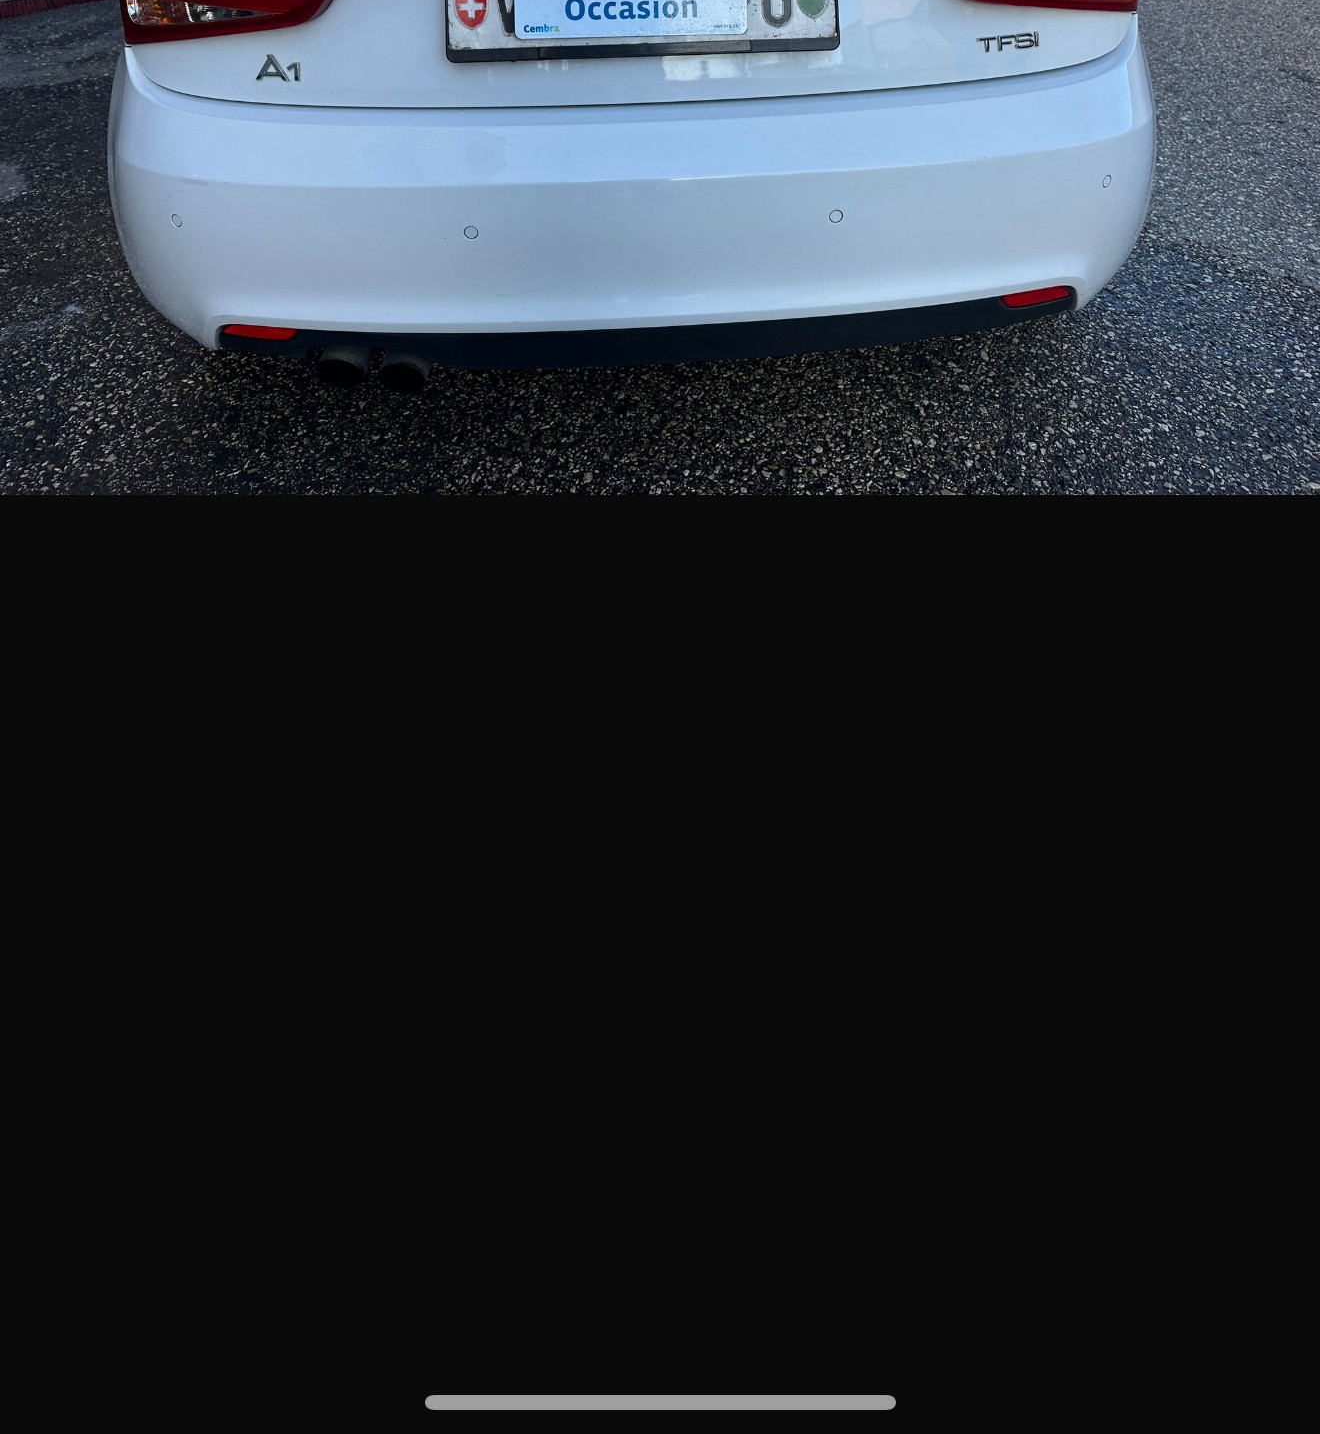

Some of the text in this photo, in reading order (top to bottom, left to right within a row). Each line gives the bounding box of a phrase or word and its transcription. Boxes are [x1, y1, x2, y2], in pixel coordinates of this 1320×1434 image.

[523, 24, 560, 33] Cembra
[976, 31, 1040, 53] TFSI
[255, 53, 301, 82] A1
